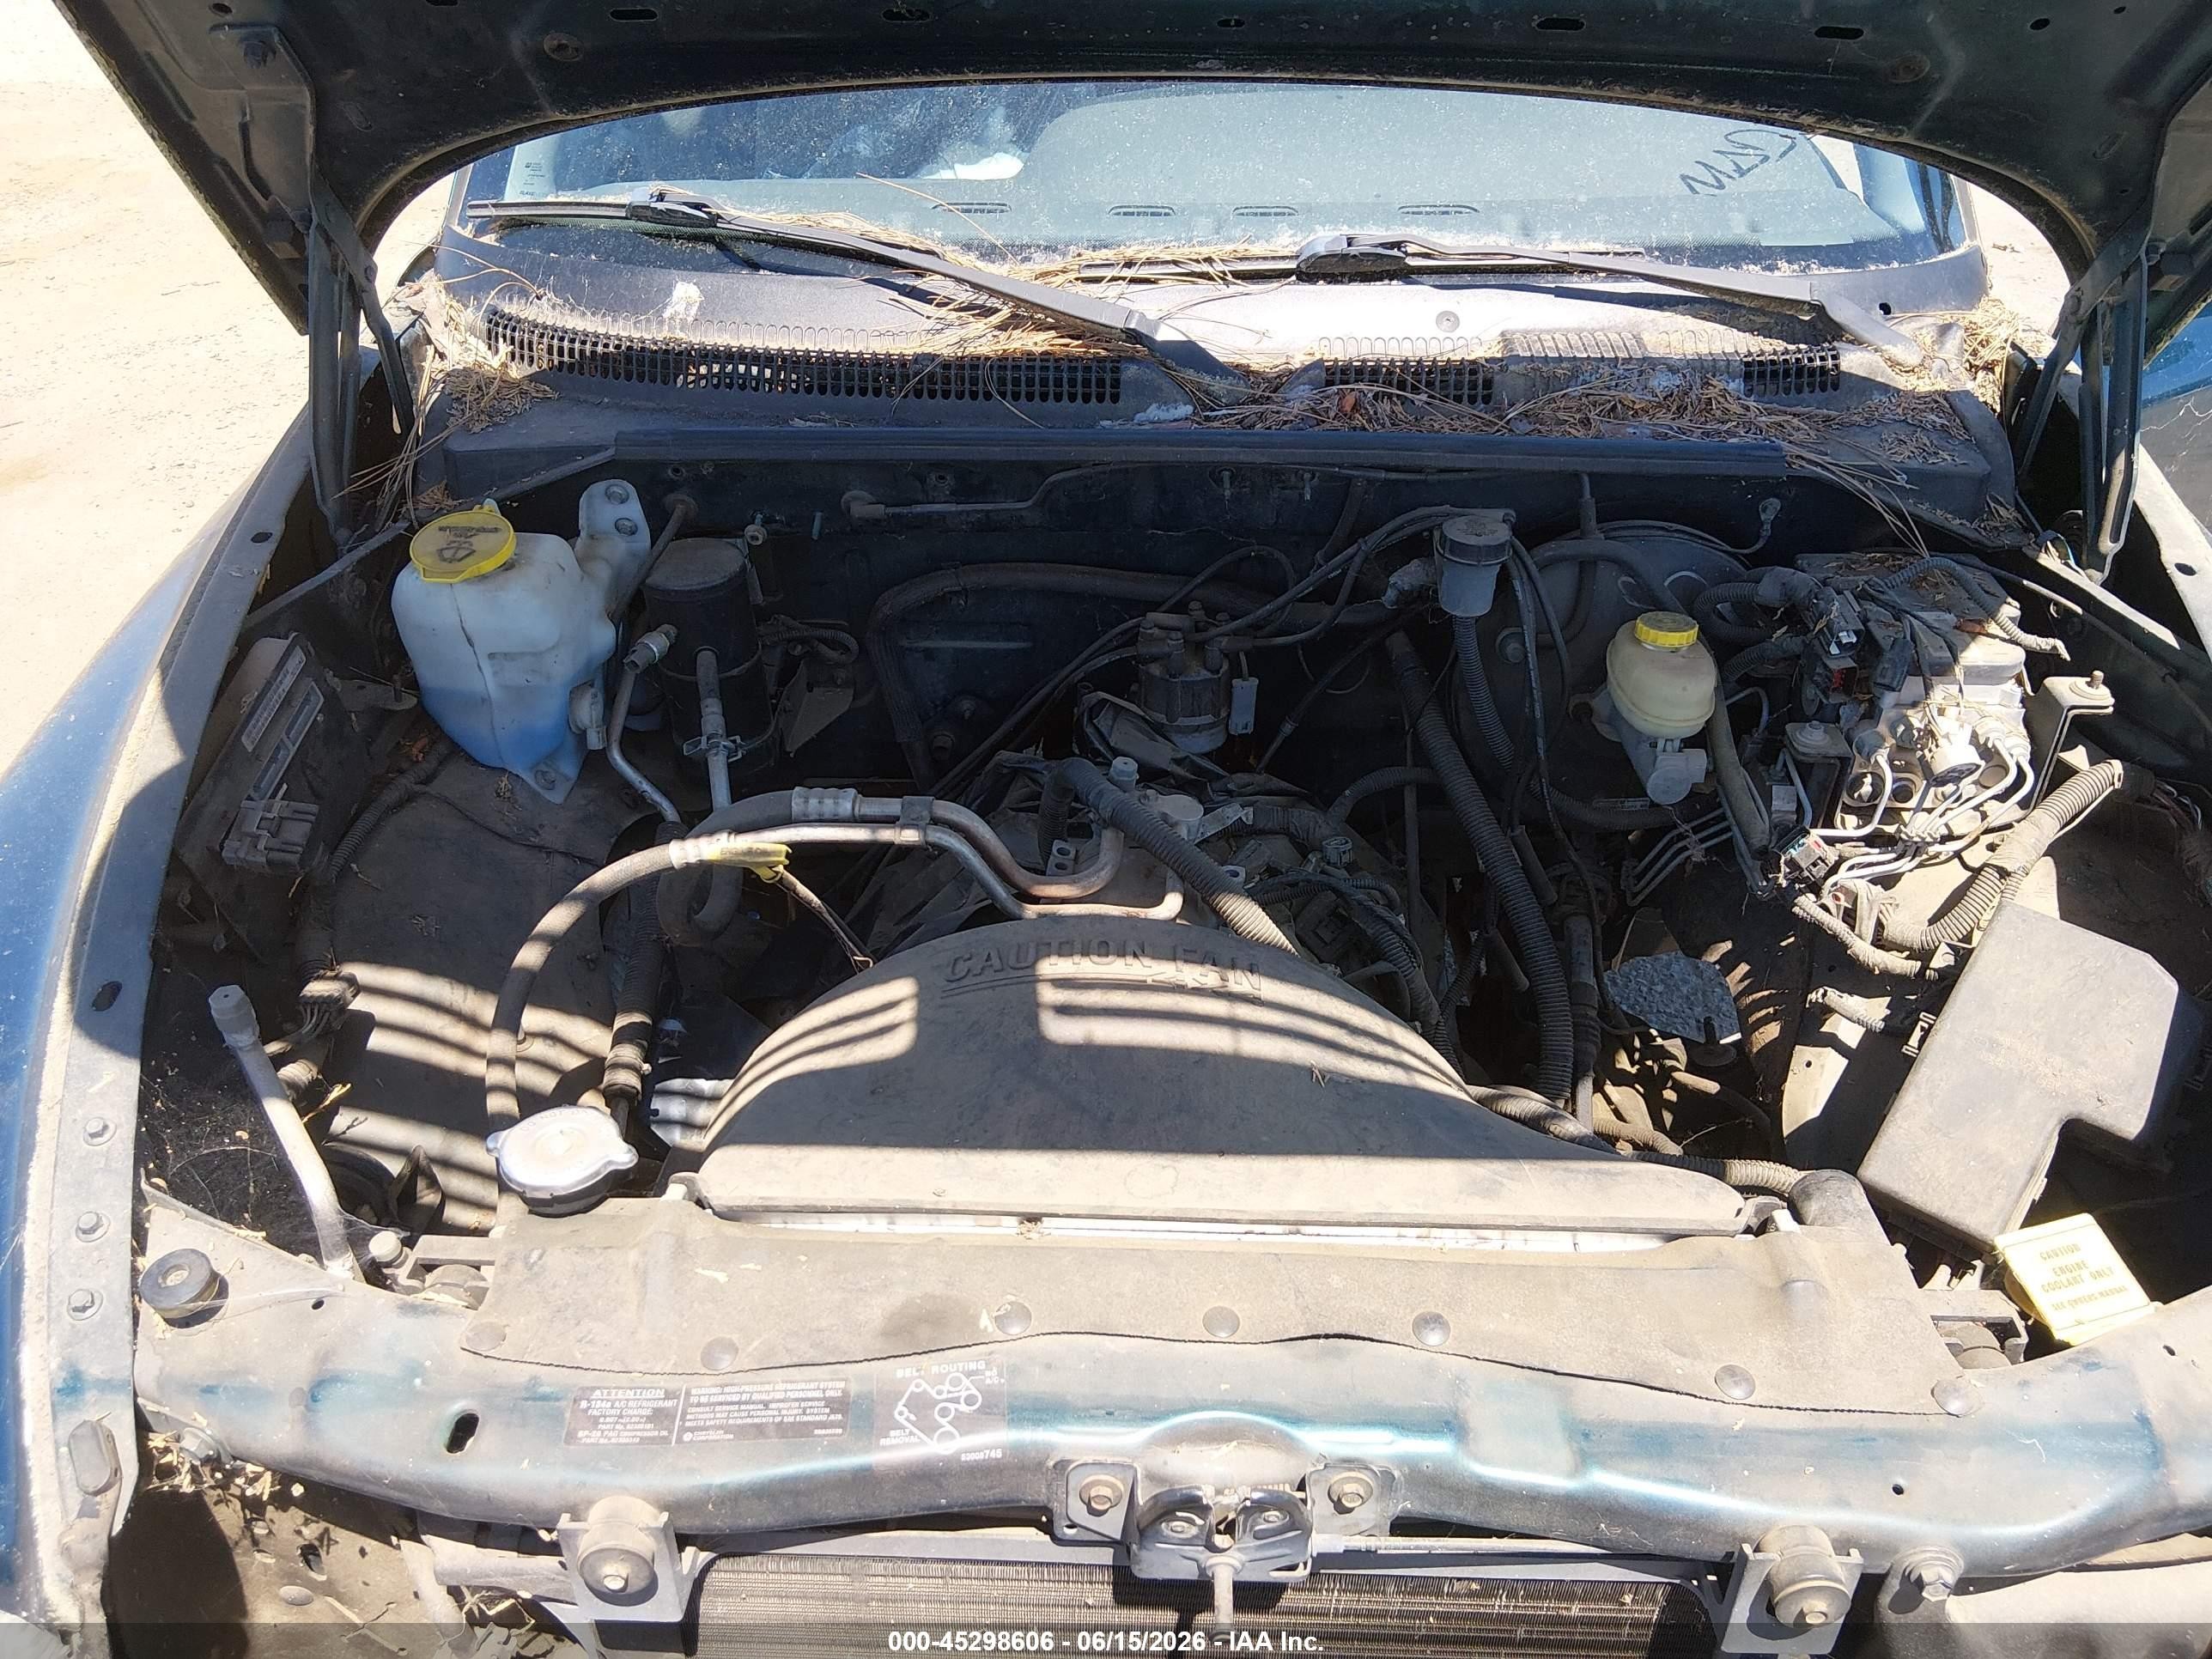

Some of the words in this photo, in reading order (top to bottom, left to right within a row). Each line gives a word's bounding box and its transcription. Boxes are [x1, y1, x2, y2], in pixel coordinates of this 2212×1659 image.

[945, 939, 1152, 982] CAUTION
[1175, 945, 1263, 991] FAN
[2039, 1243, 2081, 1261] CAUTION
[2052, 1260, 2089, 1277] ENGINE
[2040, 1274, 2085, 1293] COOLANT
[2089, 1266, 2114, 1280] ONLY
[931, 1359, 986, 1375] ROUTING
[591, 1388, 666, 1397] ATTENTION
[613, 1400, 627, 1408] A/C
[627, 1398, 678, 1408] REFRIGERANT
[690, 1395, 700, 1404] TO
[587, 1408, 620, 1417] FACTORY
[890, 1428, 911, 1437] BELT
[879, 1435, 921, 1446] REMOVAL
